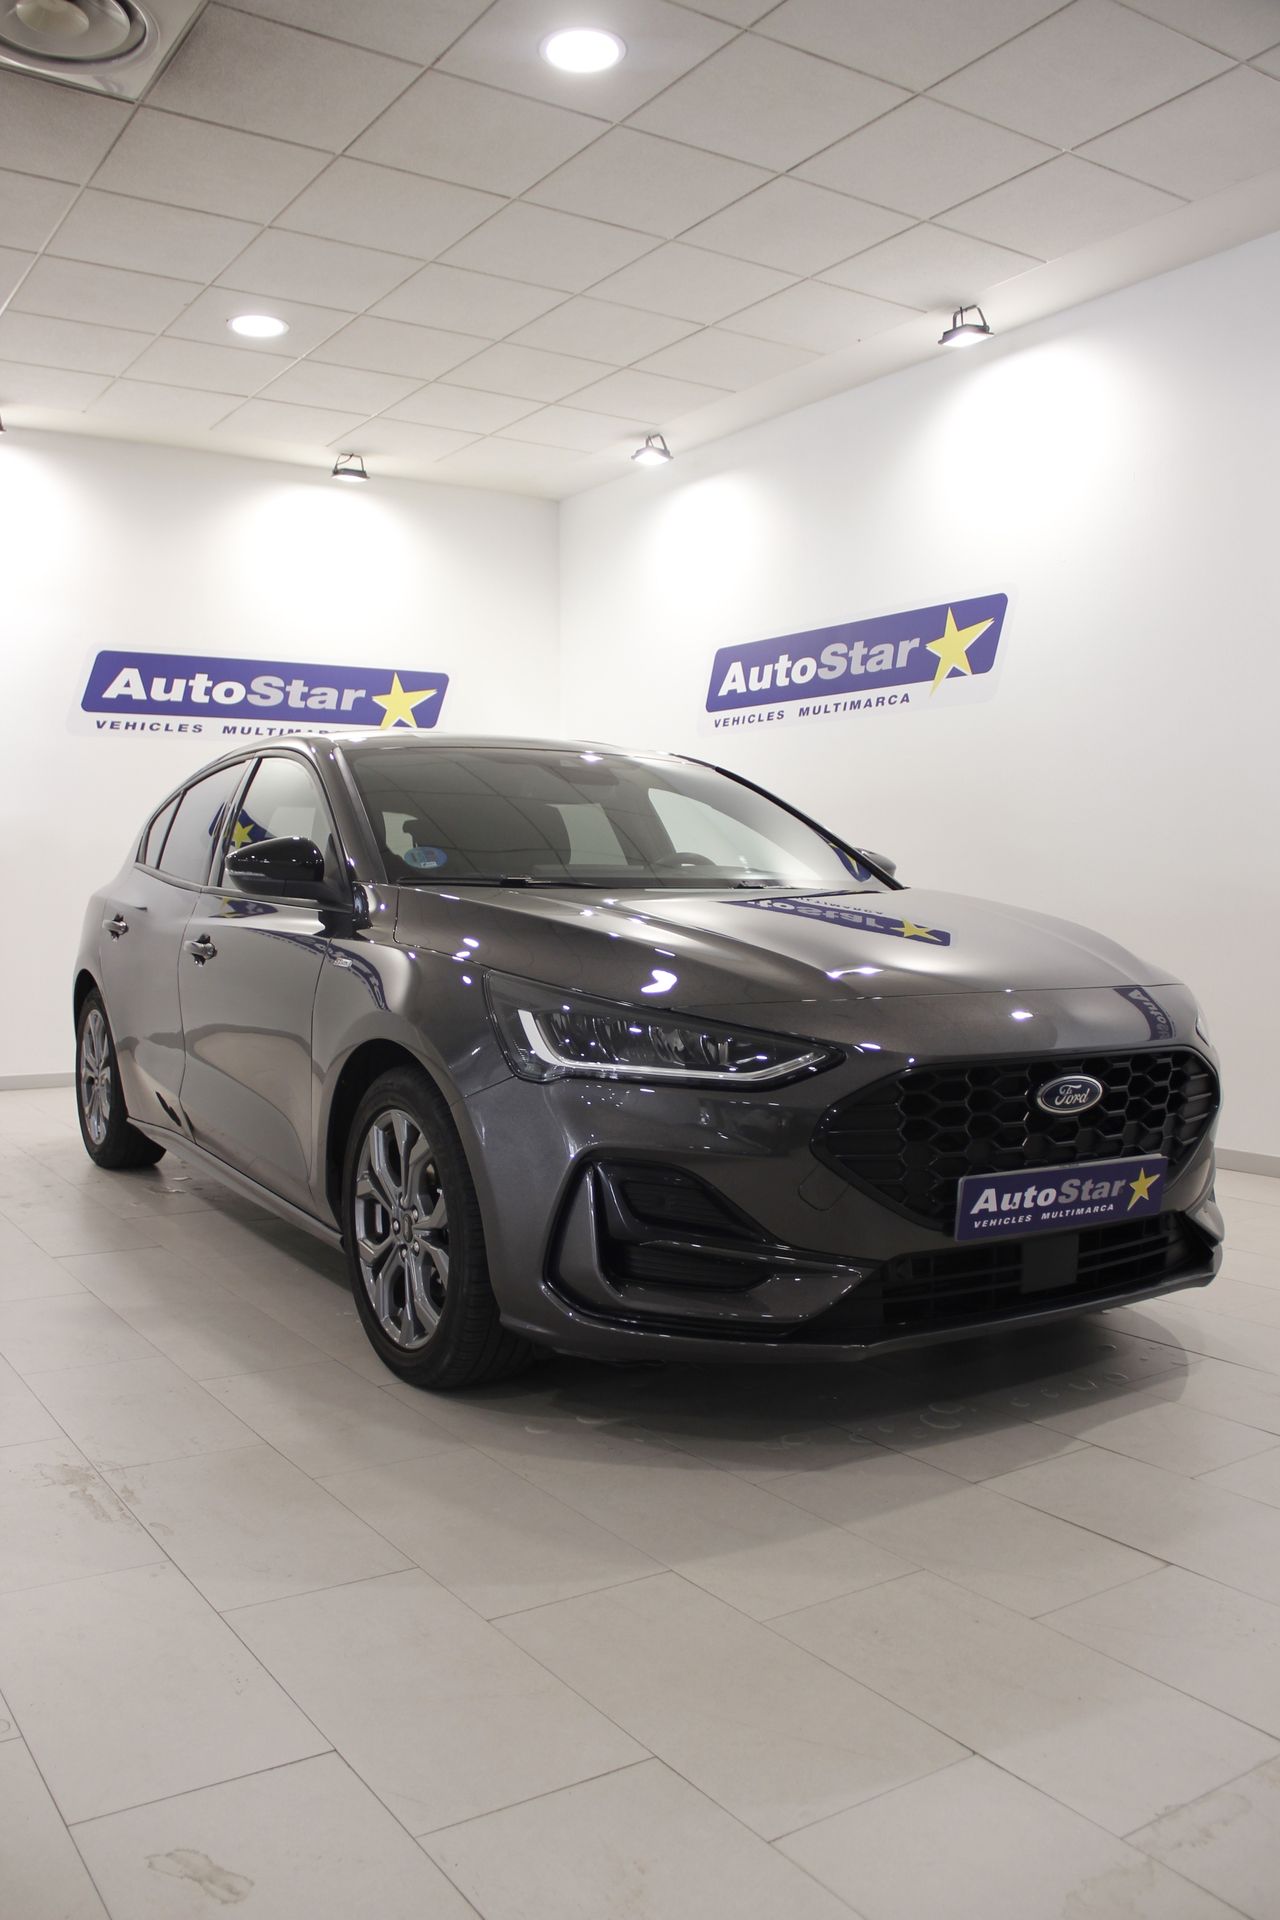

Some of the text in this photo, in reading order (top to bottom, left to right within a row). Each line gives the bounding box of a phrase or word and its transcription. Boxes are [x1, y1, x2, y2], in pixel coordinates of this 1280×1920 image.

[717, 637, 921, 697] AutoStar
[101, 667, 366, 711] AutoStar
[95, 720, 204, 734] VEHICLES
[714, 693, 911, 729] VEHICLES MULTIMARCA
[1055, 1084, 1090, 1106] Ford
[970, 1178, 1127, 1215] AutoStar
[974, 1203, 1115, 1229] VEHICLES MULTIMARCA
